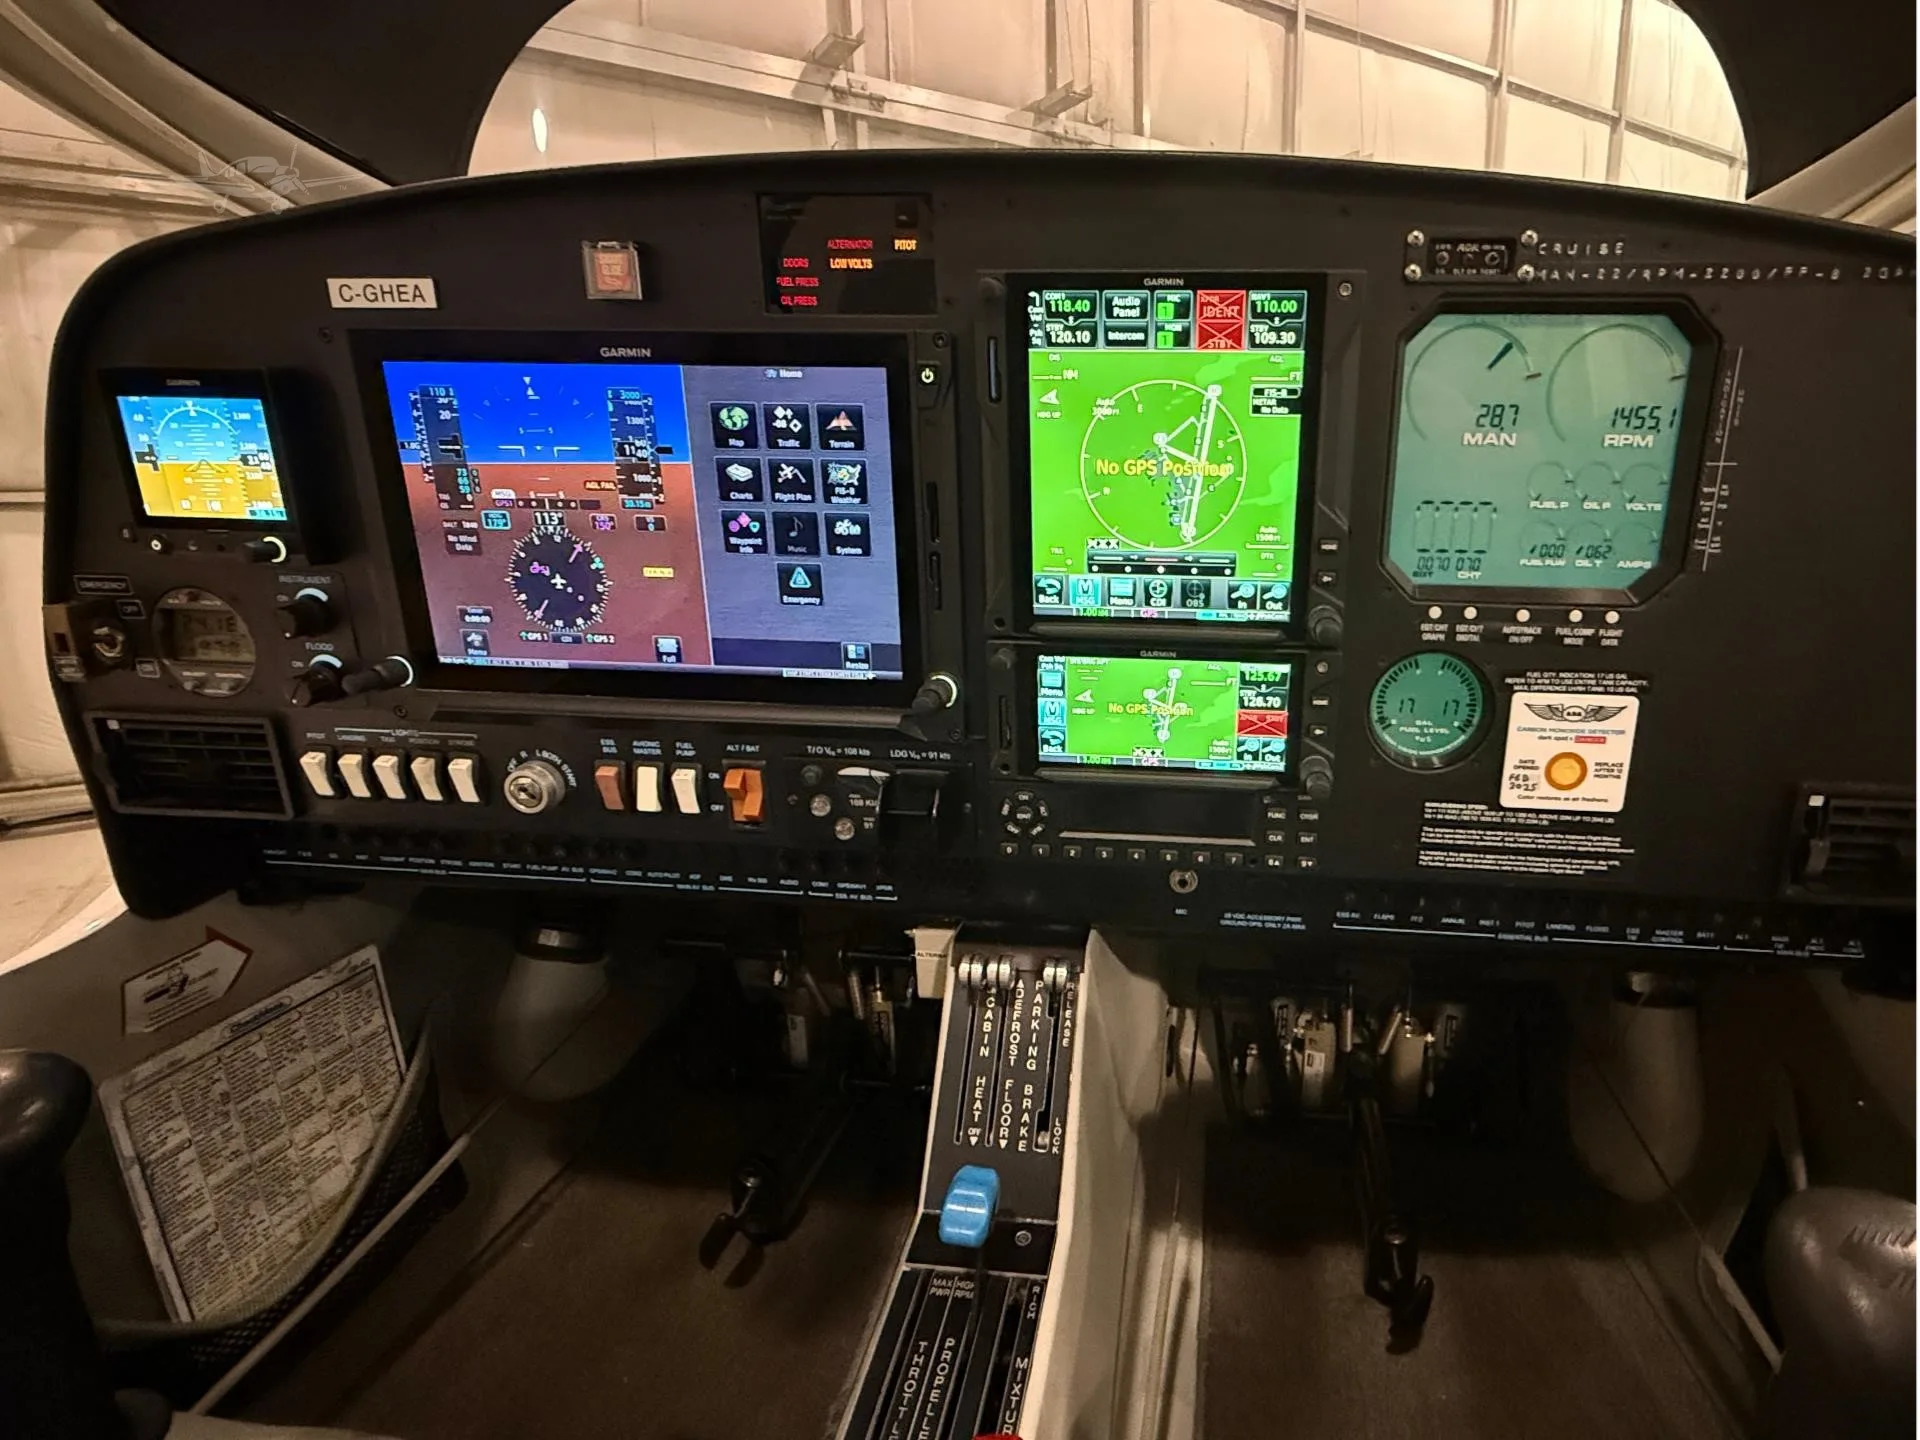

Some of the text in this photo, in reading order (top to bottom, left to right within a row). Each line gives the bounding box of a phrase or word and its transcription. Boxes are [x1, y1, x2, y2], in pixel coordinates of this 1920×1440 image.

[828, 239, 873, 250] ALTERNATOR
[894, 239, 917, 250] PITOT
[1538, 242, 1624, 256] CRUISE
[783, 258, 809, 268] DOORS
[830, 258, 873, 269] LOW VOLTS
[795, 277, 819, 288] PRESS
[1144, 277, 1184, 286] GARMIN
[338, 282, 426, 303] C-GHEA
[794, 296, 818, 306] PRESS
[1050, 300, 1091, 313] 118.40
[1112, 296, 1140, 307] Audio
[1255, 300, 1298, 313] 110.00
[1113, 307, 1140, 318] Panel
[1203, 306, 1239, 318] IDENT
[1050, 331, 1091, 344] 120.10
[1108, 331, 1145, 341] Intercom
[1254, 332, 1296, 345] 109.30
[600, 347, 651, 357] GARMIN
[1475, 403, 1520, 430] 28.7
[776, 438, 800, 449] Traffic
[829, 439, 855, 449] Terrain
[1462, 432, 1517, 447] MAN
[1604, 433, 1655, 449] RPM
[1096, 459, 1119, 476] No
[1123, 459, 1157, 477] GPS
[730, 491, 753, 500] Charts
[775, 491, 812, 503] Flight Plan
[1529, 501, 1569, 509] FUEL P
[1583, 502, 1611, 510] OIL P
[836, 546, 862, 556] System
[1575, 559, 1592, 567] OIL
[1457, 571, 1482, 579] CHT
[783, 595, 820, 606] Emergency
[305, 642, 334, 651] FLOOD
[1108, 702, 1123, 713] No
[1126, 703, 1148, 715] GPS
[676, 741, 694, 750] FUEL
[726, 744, 760, 753] ALT BAT
[520, 750, 528, 758] R
[633, 748, 662, 756] MASTER
[676, 749, 696, 757] PUMP
[890, 749, 908, 758] LDG
[561, 763, 577, 787] START
[1508, 782, 1538, 791] 2025
[710, 803, 725, 812] OFF
[1268, 834, 1283, 842] CLR
[1062, 982, 1076, 1047] RELEASE
[1008, 988, 1024, 1067] DEFROST
[972, 997, 996, 1122] CABIN HEAT
[1018, 981, 1044, 1152] PARKING BRAKE
[1000, 1079, 1015, 1138] FLOOR
[968, 1127, 981, 1136] OFF
[1052, 1117, 1061, 1154] LOCK
[932, 1277, 953, 1287] MAX
[929, 1287, 950, 1297] PWR
[918, 1337, 955, 1440] PROPELLE
[1002, 1356, 1029, 1436] MIXTUR
